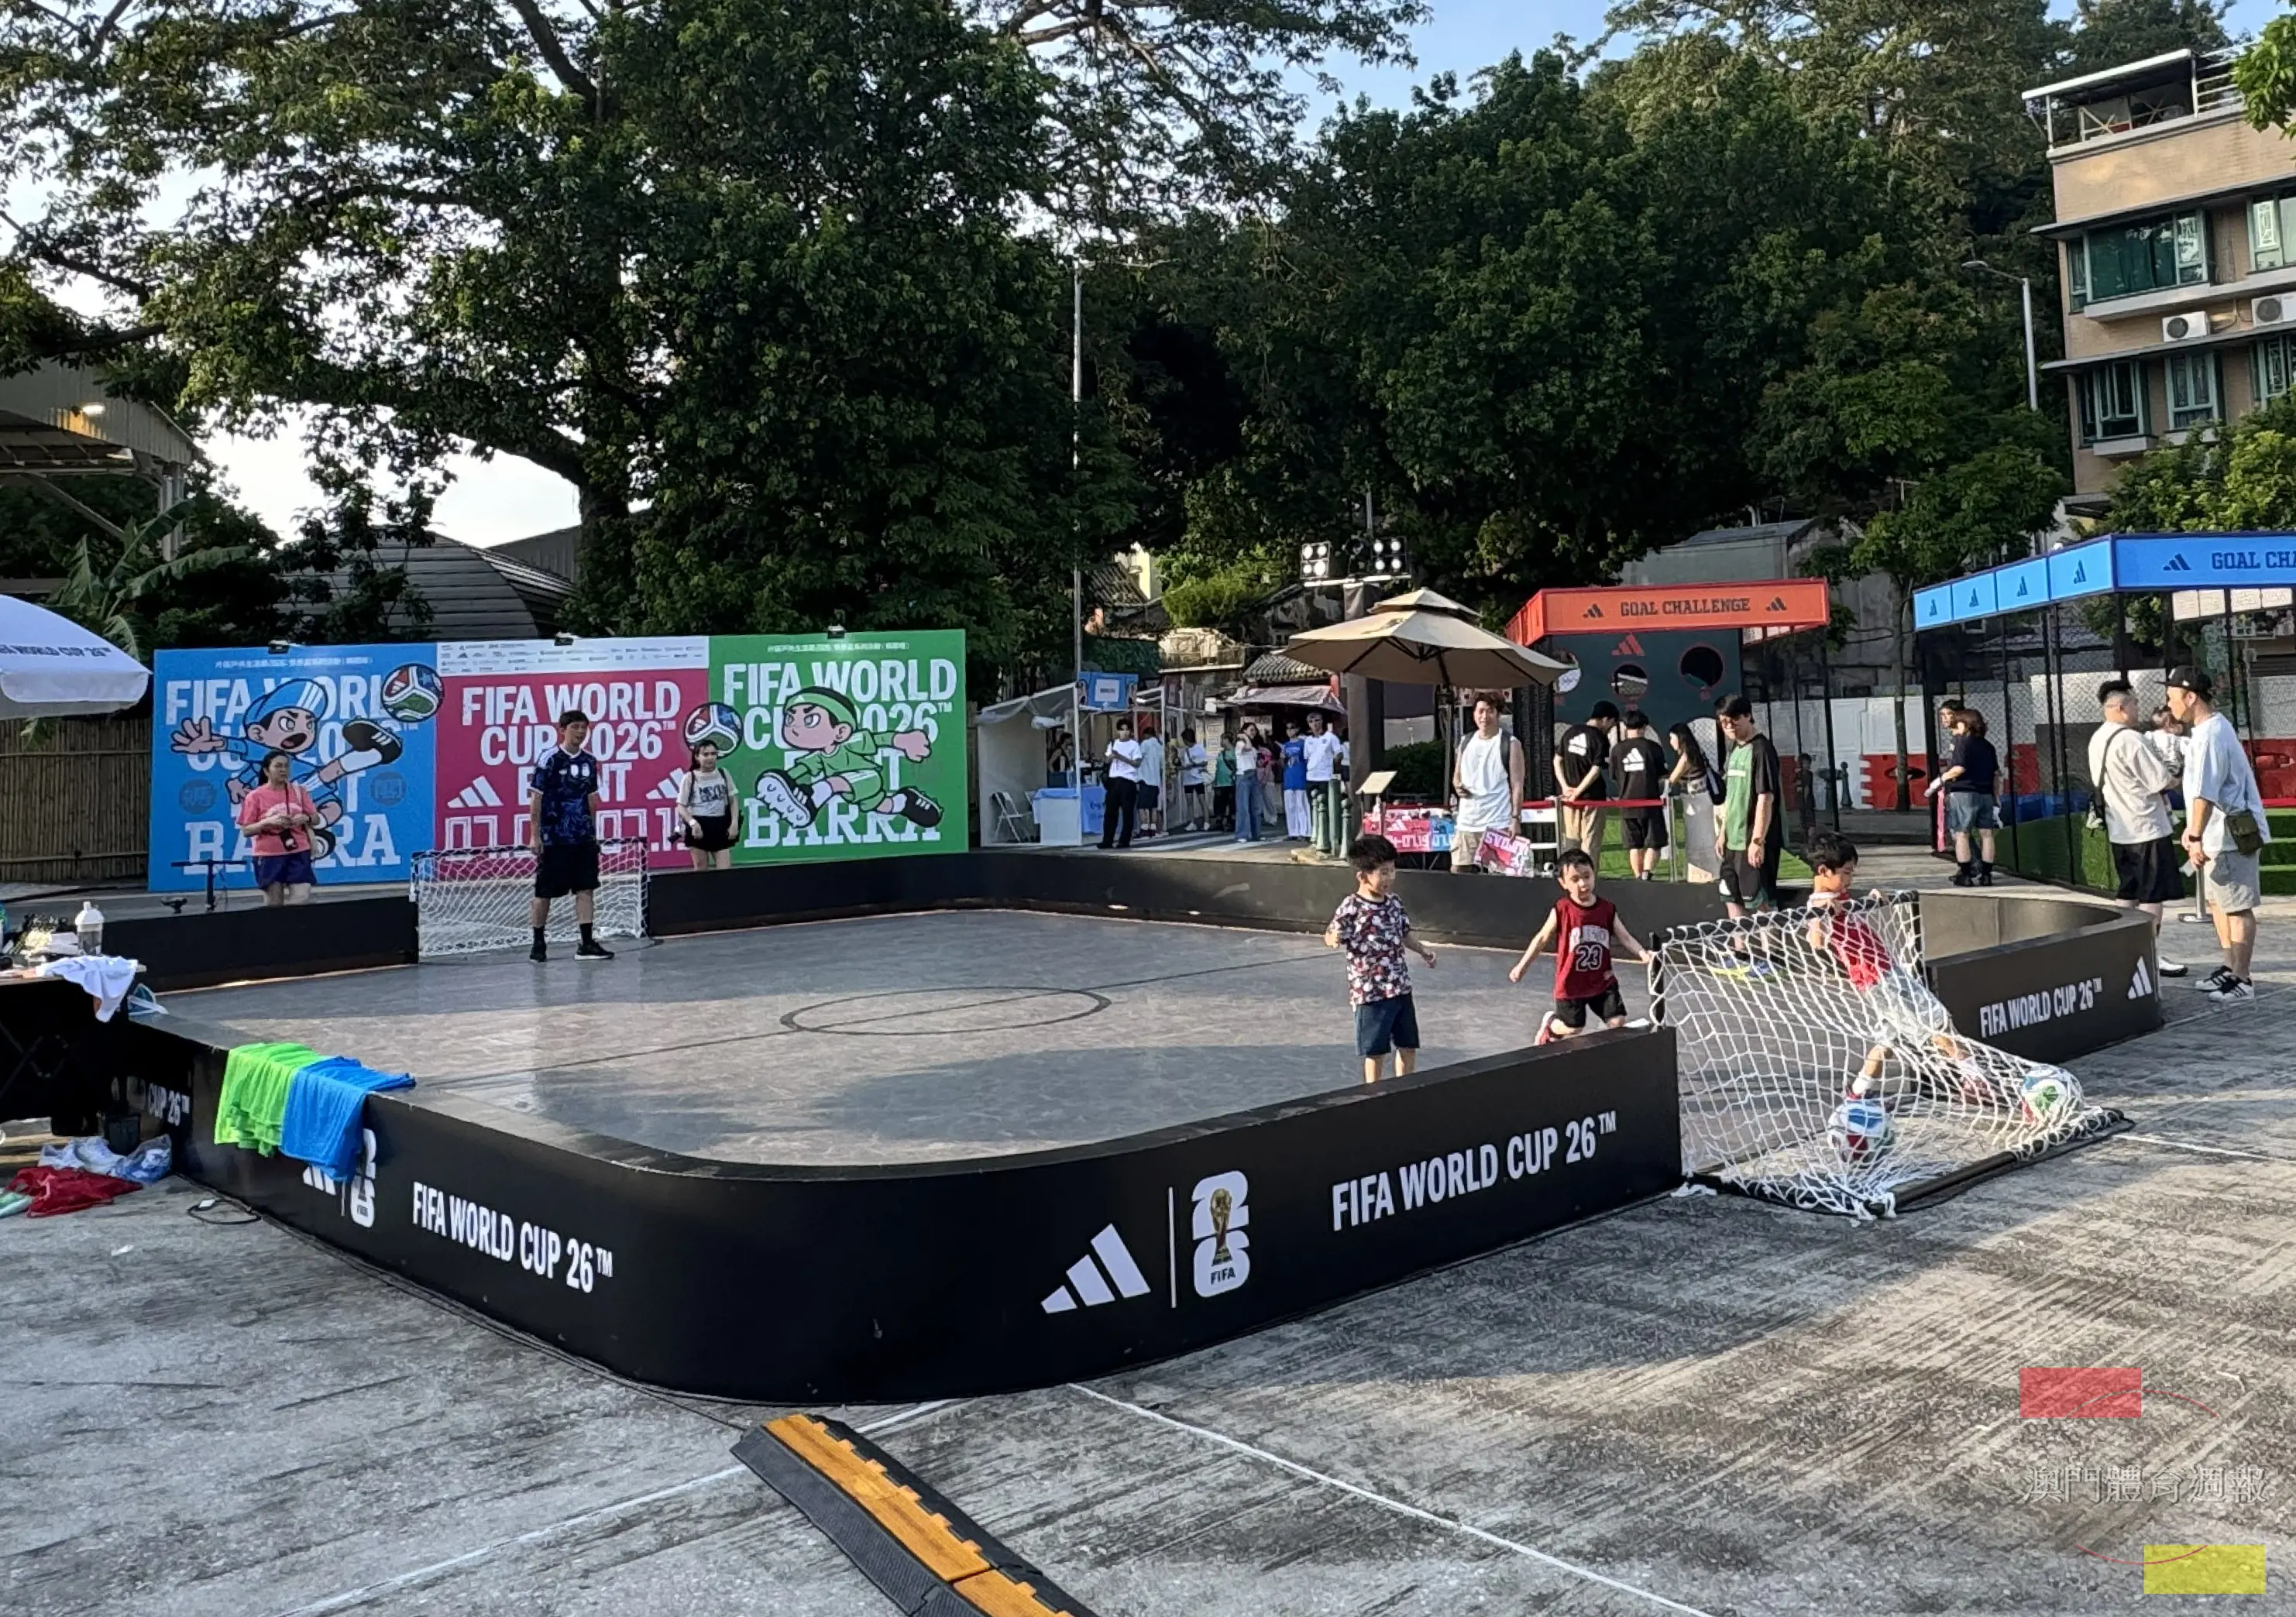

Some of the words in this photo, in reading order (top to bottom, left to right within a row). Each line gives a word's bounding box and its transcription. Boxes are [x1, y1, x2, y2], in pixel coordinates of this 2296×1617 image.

[2212, 551, 2261, 569] GOAL
[1621, 602, 1658, 616] GOAL
[1663, 598, 1751, 614] CHALLENGE
[165, 678, 252, 726] FIFA
[462, 685, 538, 726] FIFA
[544, 681, 681, 723] WORLD
[724, 662, 802, 706] FIFA
[811, 658, 957, 702] WORLD
[480, 724, 559, 767] CUP
[1576, 945, 1603, 971] 23
[1979, 1002, 2009, 1038] FIFA
[2008, 990, 2051, 1030] WORLD
[2053, 984, 2077, 1018] CUP
[1332, 1172, 1395, 1231] FIFA
[1399, 1144, 1498, 1210] WORLD
[1507, 1127, 1559, 1179] CUP
[413, 1181, 447, 1237] FIFA
[449, 1195, 514, 1262] WORLD
[520, 1221, 561, 1279] CUP
[1210, 1266, 1236, 1286] FIFA
